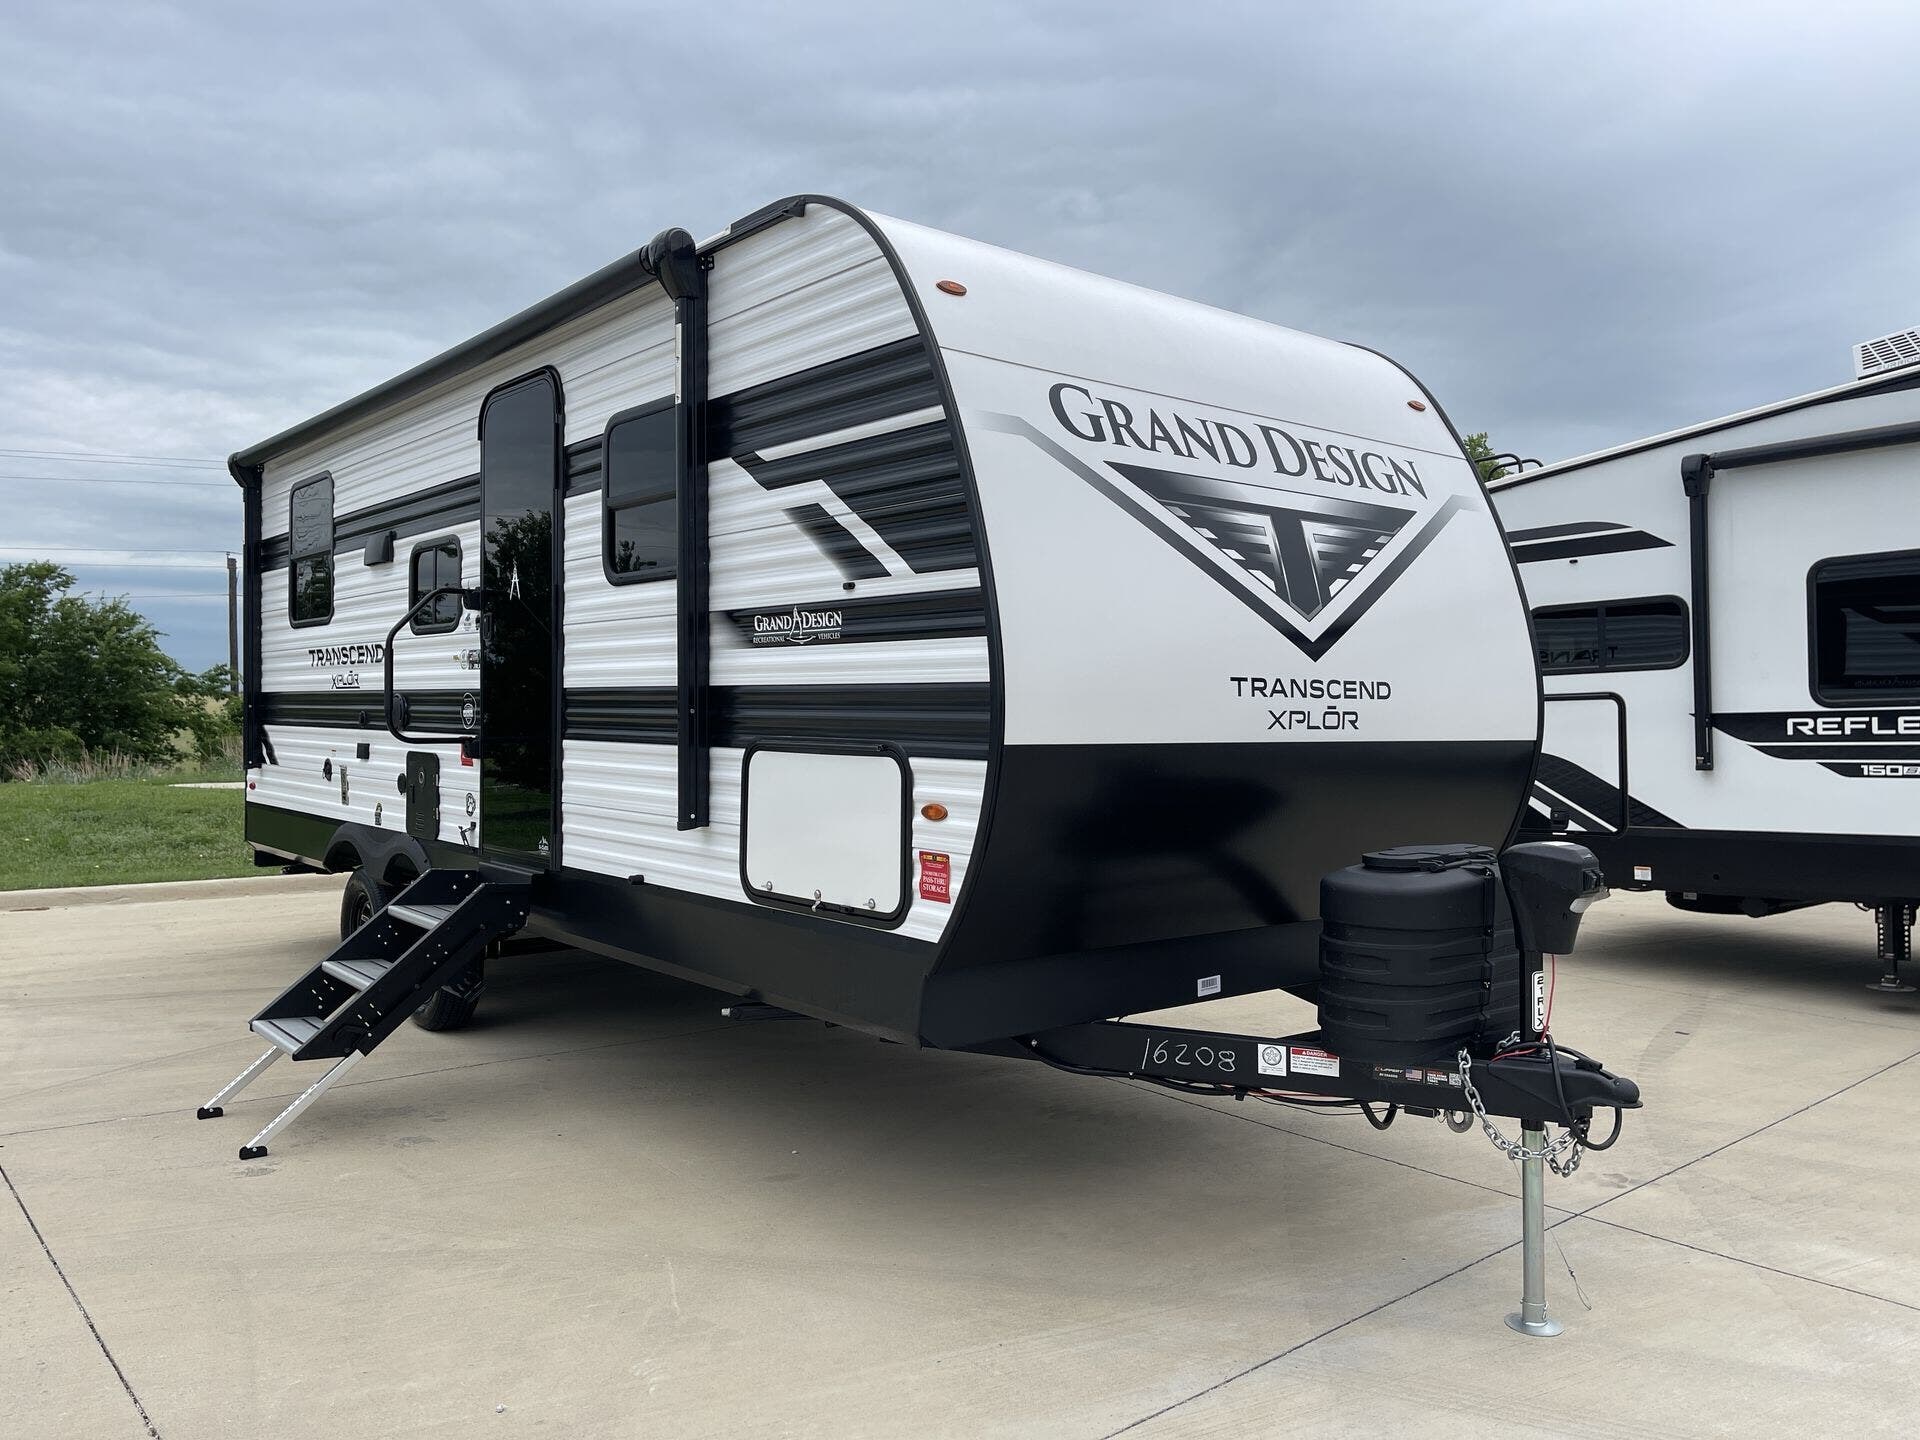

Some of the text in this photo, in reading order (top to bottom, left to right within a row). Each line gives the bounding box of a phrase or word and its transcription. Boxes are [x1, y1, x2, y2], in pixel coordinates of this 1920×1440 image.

[1048, 382, 1429, 500] GRAND DESIGN
[754, 611, 842, 632] GRAND DESIGN
[308, 644, 384, 667] TRANSCEND
[1230, 676, 1392, 700] TRANSCEND
[1786, 716, 1920, 736] REFLE
[1141, 1038, 1236, 1072] 16208
